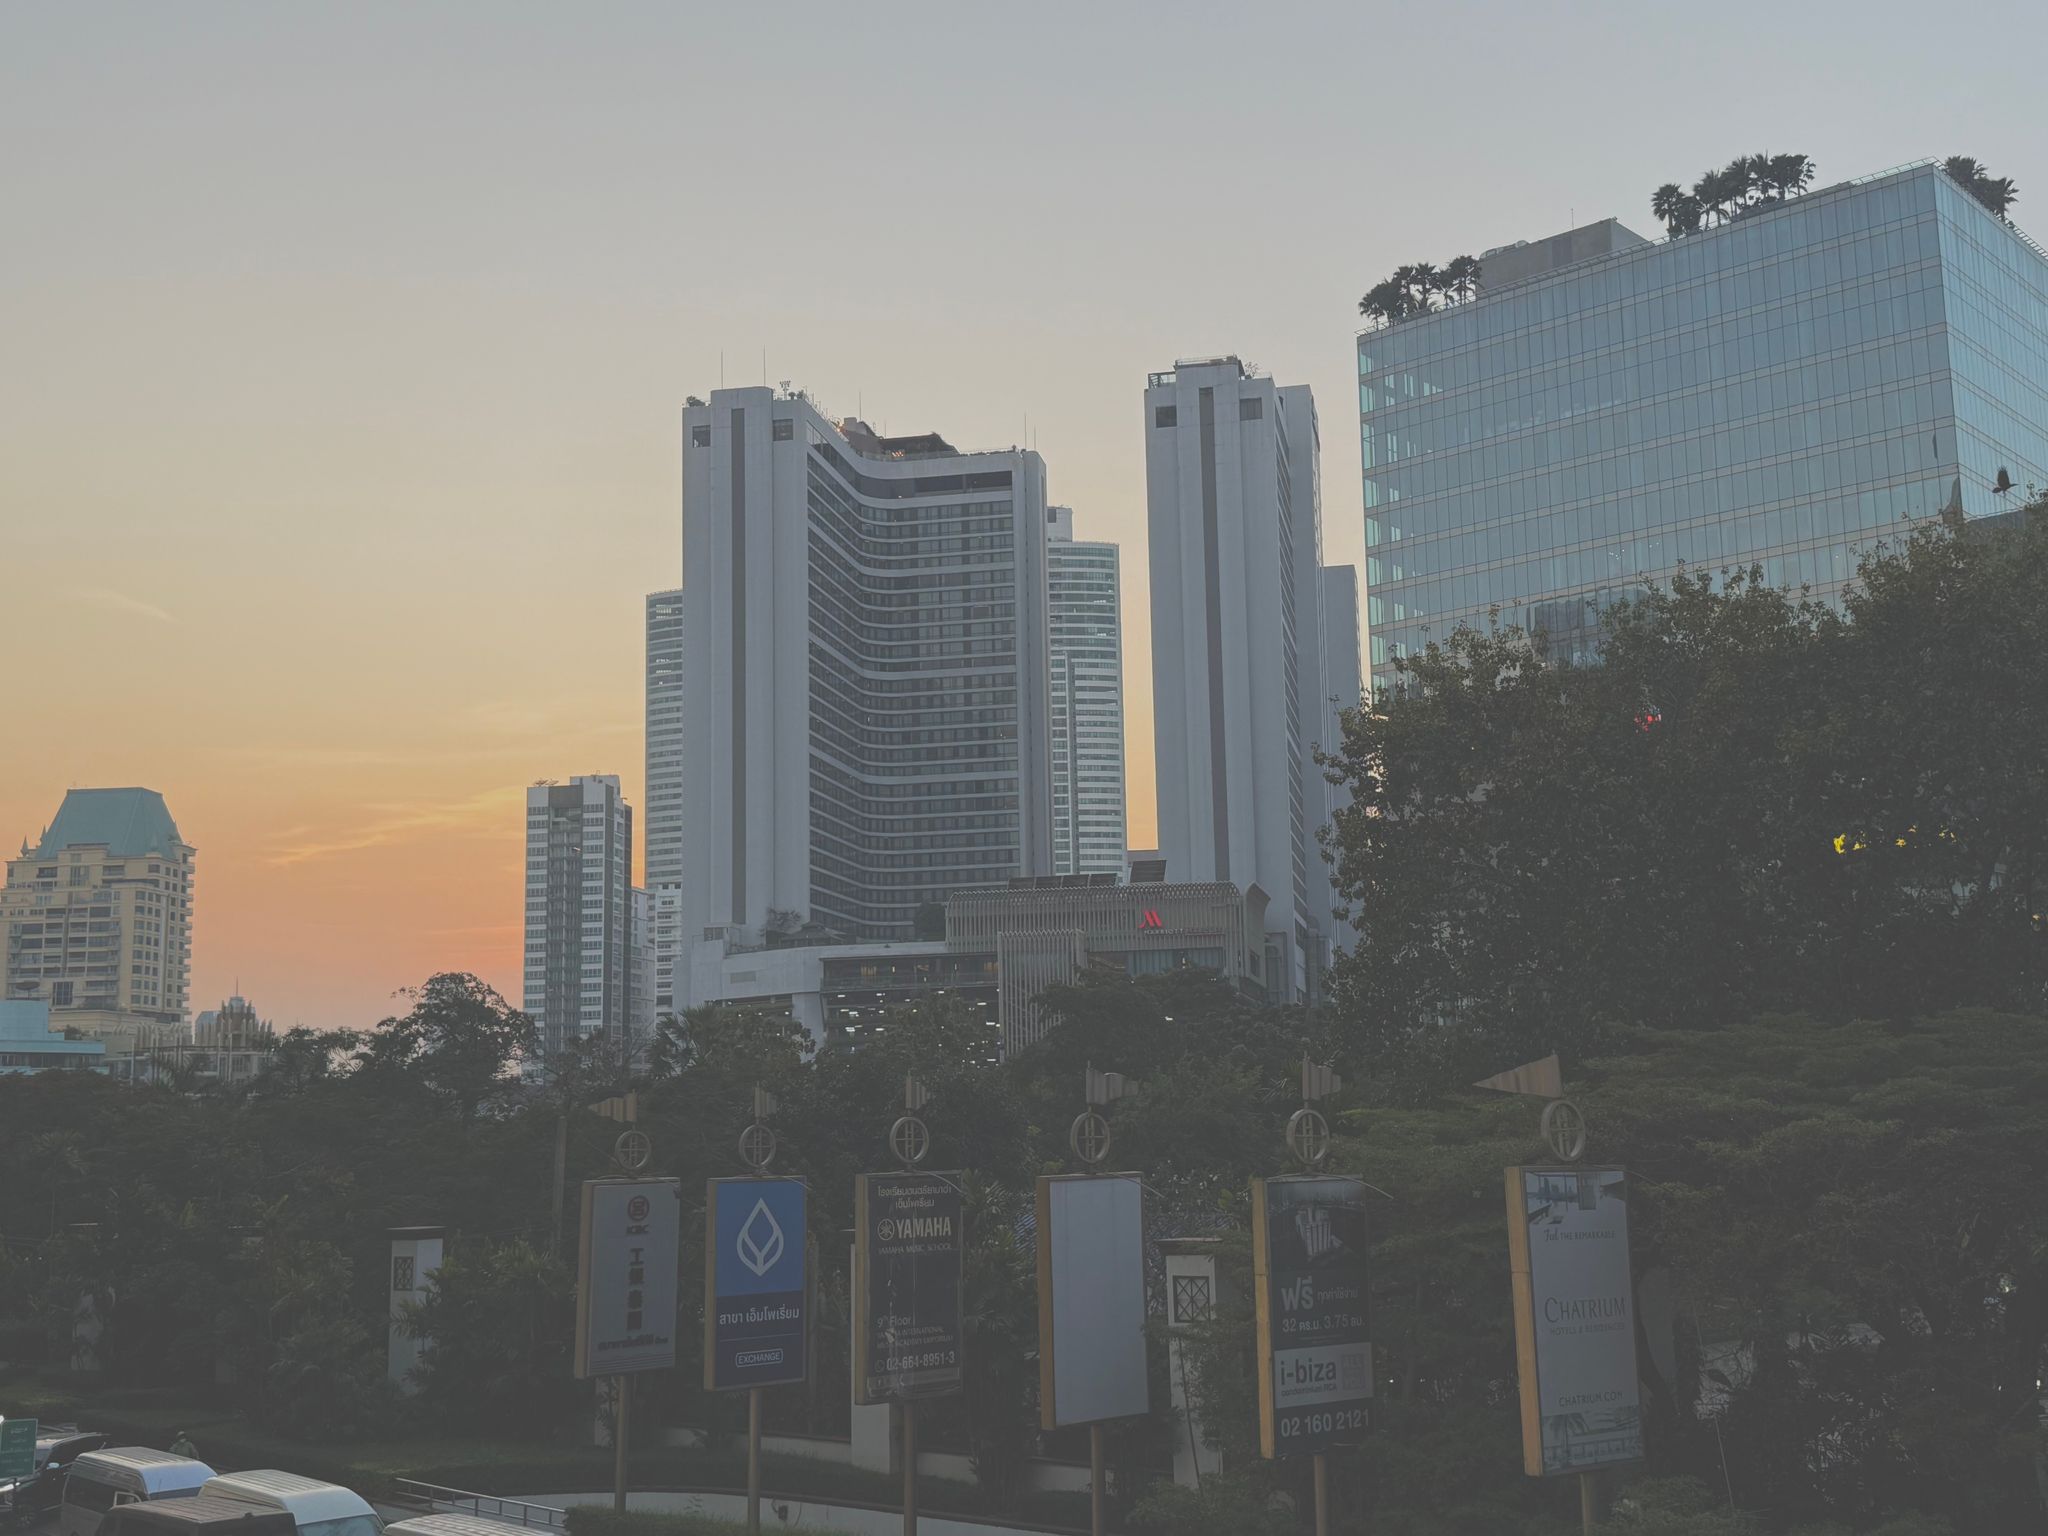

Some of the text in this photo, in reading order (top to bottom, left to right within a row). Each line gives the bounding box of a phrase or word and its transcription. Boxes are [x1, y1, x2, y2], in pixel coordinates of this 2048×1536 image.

[896, 1216, 952, 1239] YAMAHA
[927, 1242, 953, 1251] SCHOOL
[1281, 1275, 1313, 1311] ฟรี
[719, 1311, 743, 1325] สาขา
[890, 1315, 912, 1327] Floor
[1282, 1318, 1297, 1333] 32
[1324, 1314, 1349, 1329] 3.75
[1551, 1326, 1577, 1336] HOTELS
[738, 1351, 780, 1365] EXCHANGE
[1280, 1358, 1337, 1386] i-biza
[1558, 1391, 1623, 1407] CHATRIUM.COM
[1281, 1409, 1369, 1437] 02 160 2121
